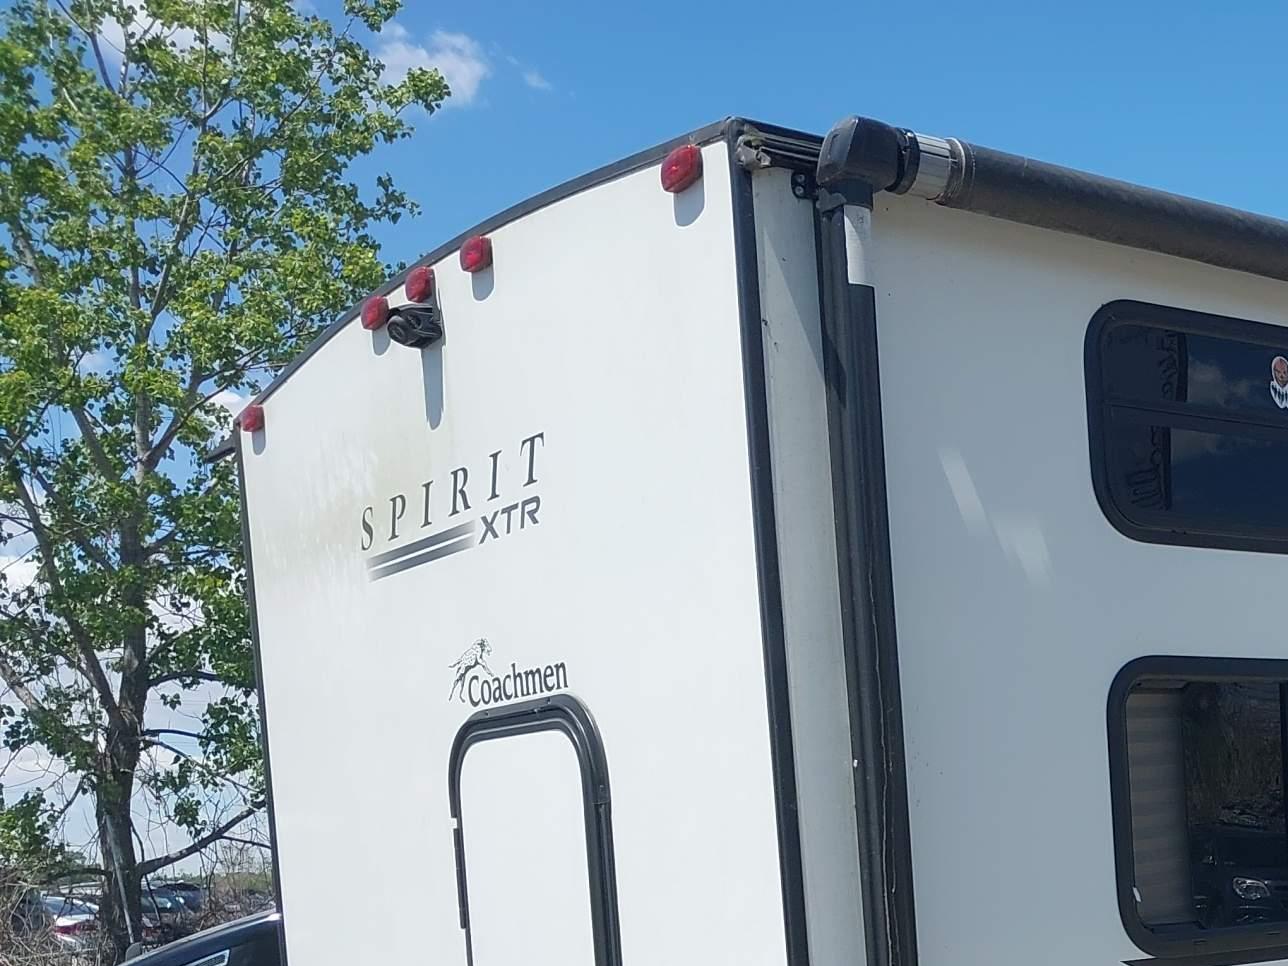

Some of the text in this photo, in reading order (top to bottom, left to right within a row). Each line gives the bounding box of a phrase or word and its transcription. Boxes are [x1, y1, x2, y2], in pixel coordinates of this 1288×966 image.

[360, 432, 545, 551] SPIRIT
[479, 495, 541, 545] XTR
[468, 661, 568, 707] Coachmen
